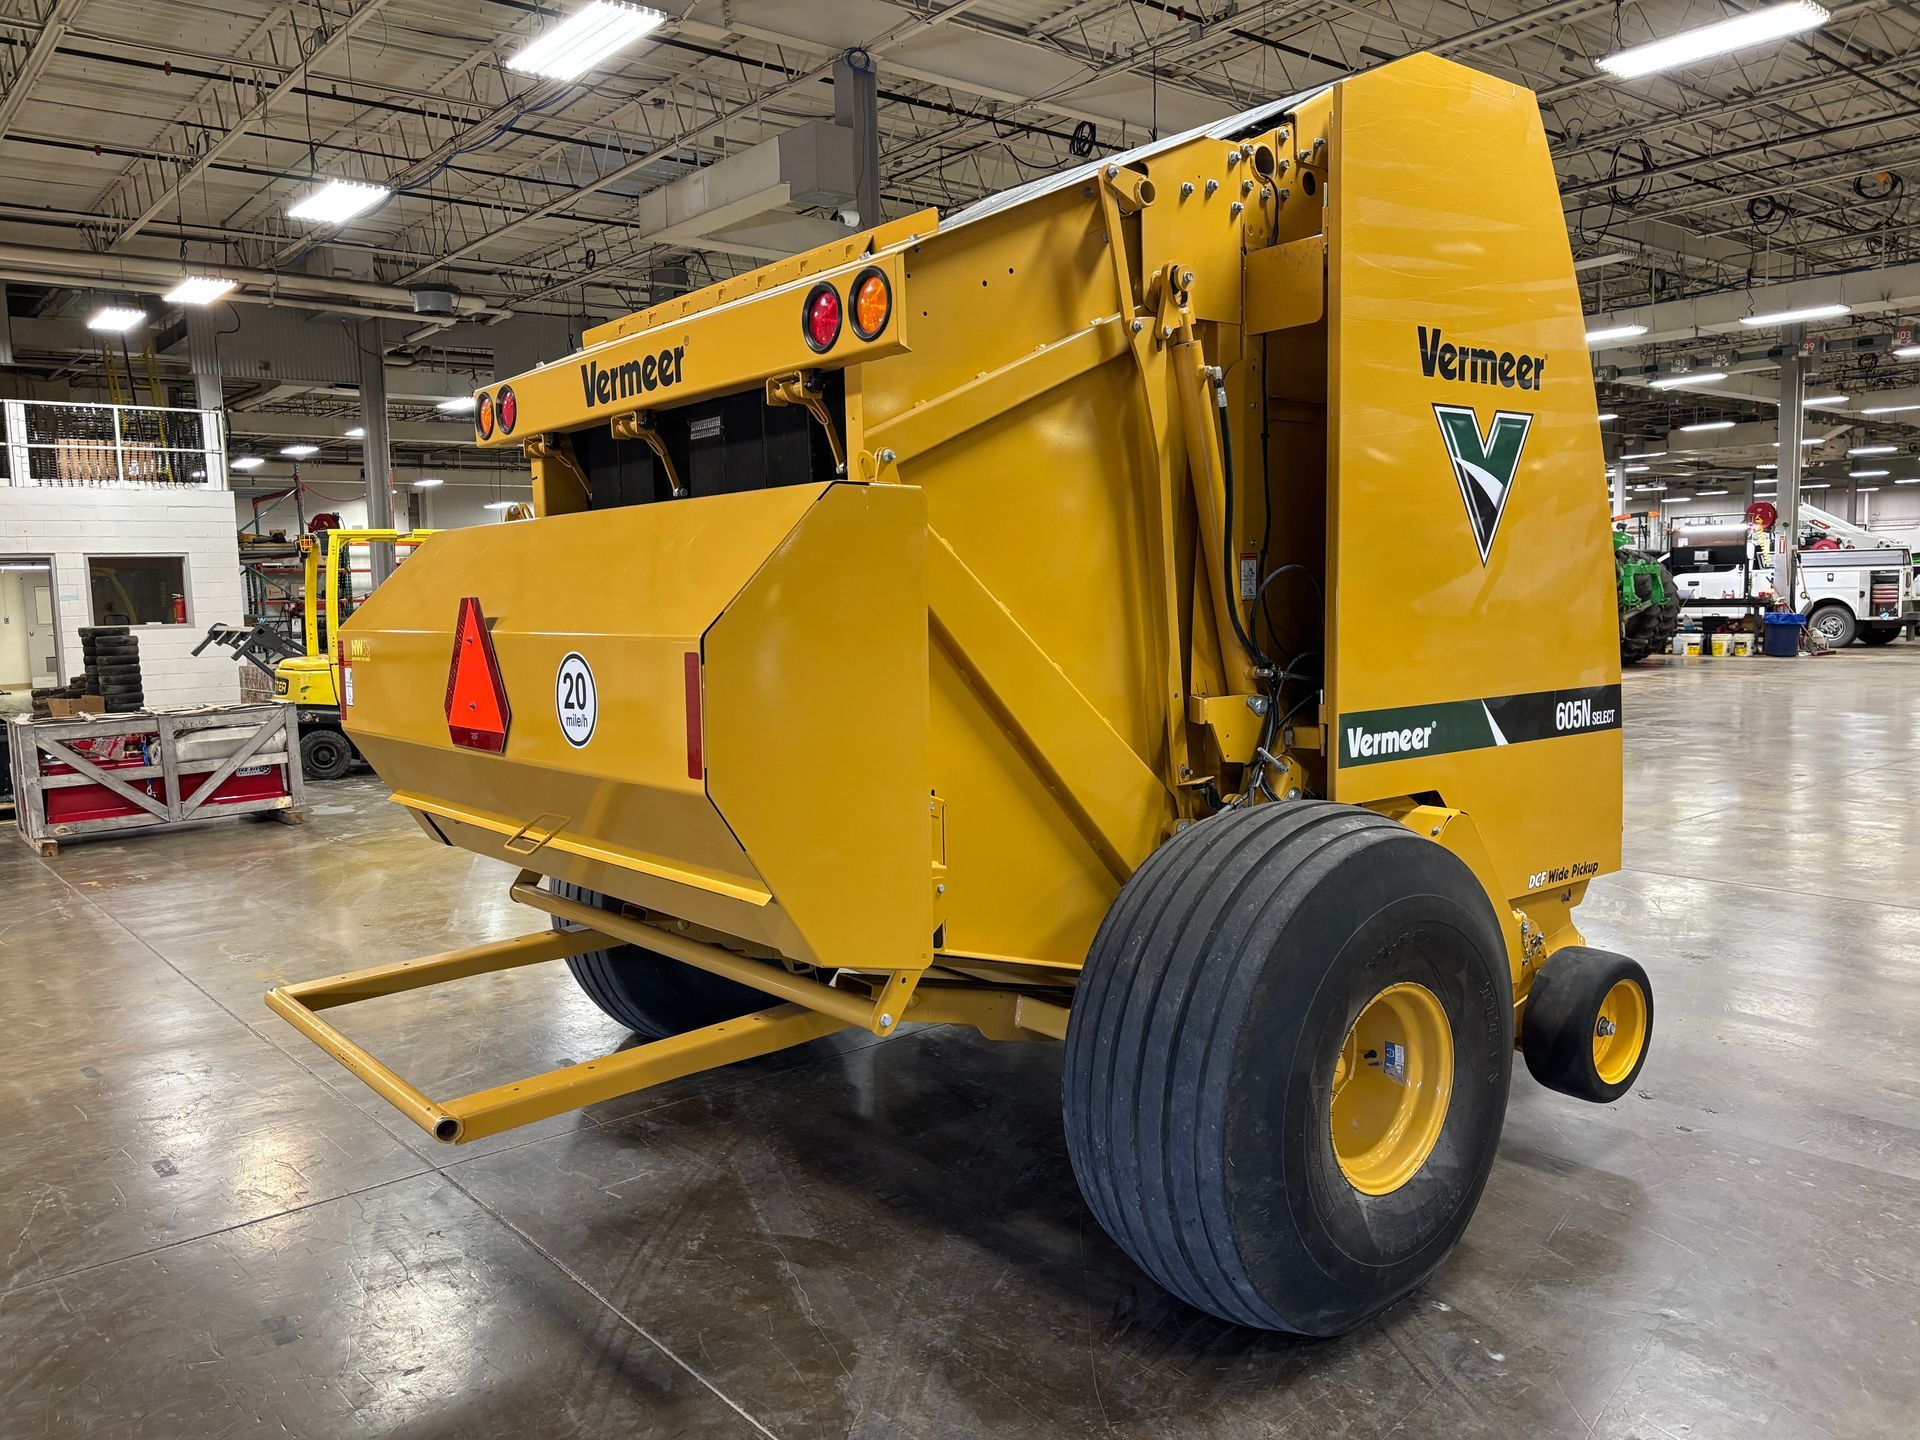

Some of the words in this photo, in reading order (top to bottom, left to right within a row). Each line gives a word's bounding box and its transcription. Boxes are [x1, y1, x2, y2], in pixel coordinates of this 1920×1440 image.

[1417, 325, 1545, 391] Vermeer
[581, 346, 685, 408] Vermeer
[563, 672, 587, 710] 20
[1556, 699, 1591, 731] 605N
[1591, 709, 1615, 726] SELECT
[1347, 726, 1432, 758] Vermeer
[1528, 871, 1547, 890] DCF
[1548, 867, 1569, 884] Wide
[1571, 861, 1599, 878] Pickup
